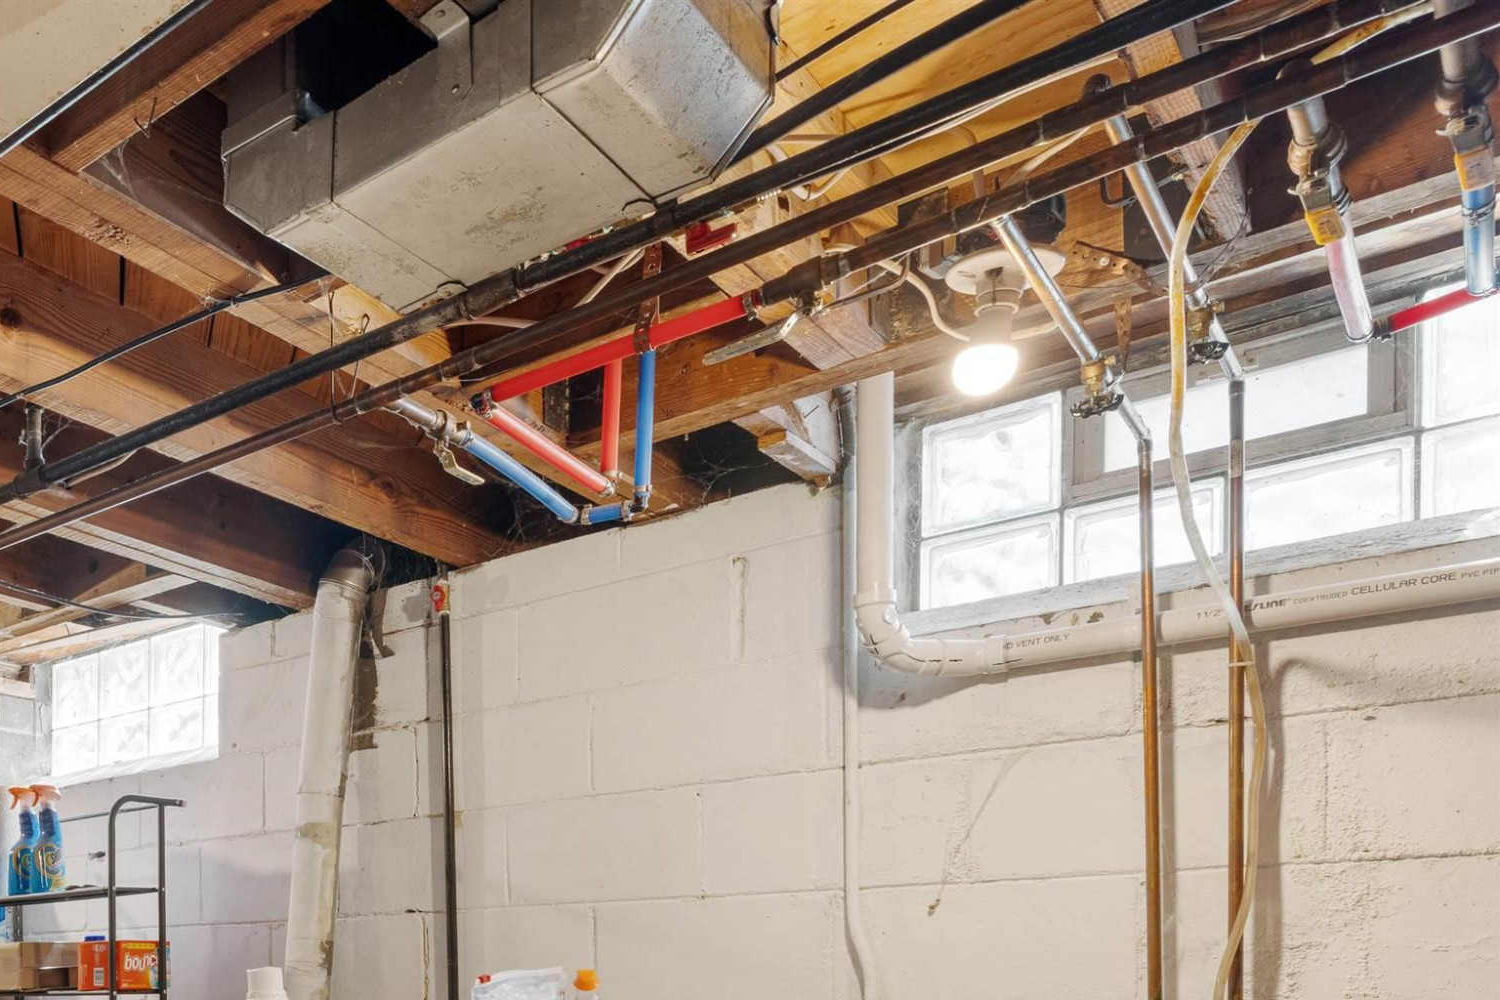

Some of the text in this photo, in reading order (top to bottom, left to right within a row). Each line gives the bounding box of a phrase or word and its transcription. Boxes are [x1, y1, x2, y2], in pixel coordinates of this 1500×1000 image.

[1293, 591, 1348, 605] COEXTRUDED
[1351, 578, 1416, 596] CELLULAR
[1421, 571, 1457, 585] CORE
[1461, 570, 1479, 578] PVC
[1482, 567, 1500, 576] PIP
[1015, 637, 1040, 648] VENT
[1043, 632, 1070, 644] ONLY
